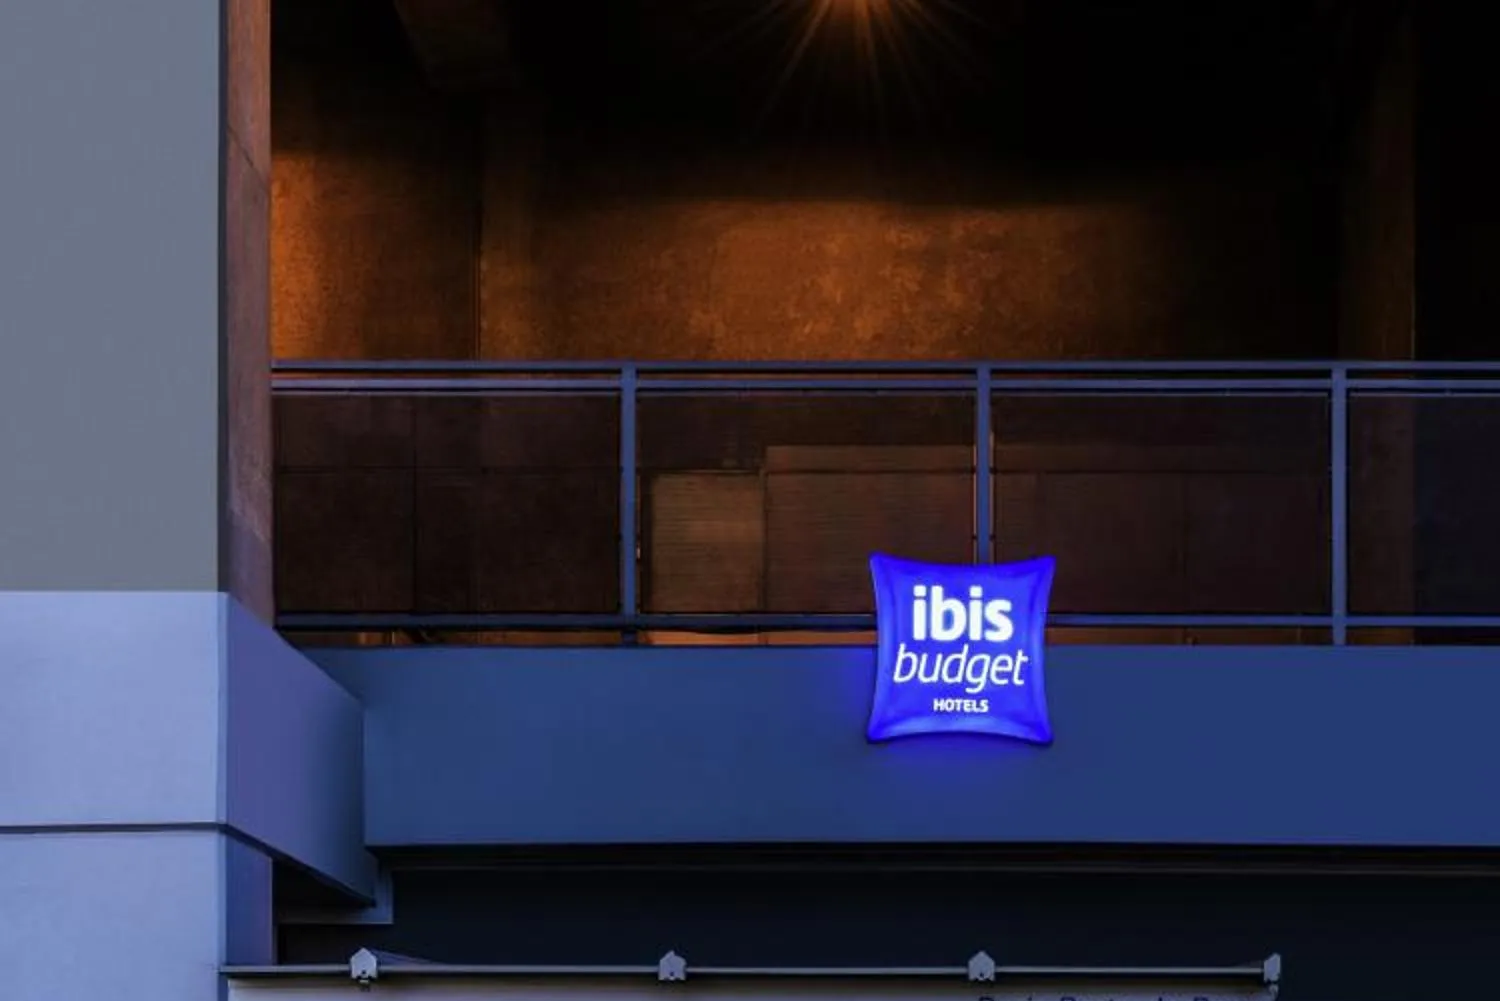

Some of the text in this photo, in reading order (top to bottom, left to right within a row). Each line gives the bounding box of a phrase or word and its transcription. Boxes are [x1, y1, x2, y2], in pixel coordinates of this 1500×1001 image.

[912, 585, 1014, 642] ibis
[893, 643, 1029, 694] budget
[932, 698, 990, 714] HOTELS
